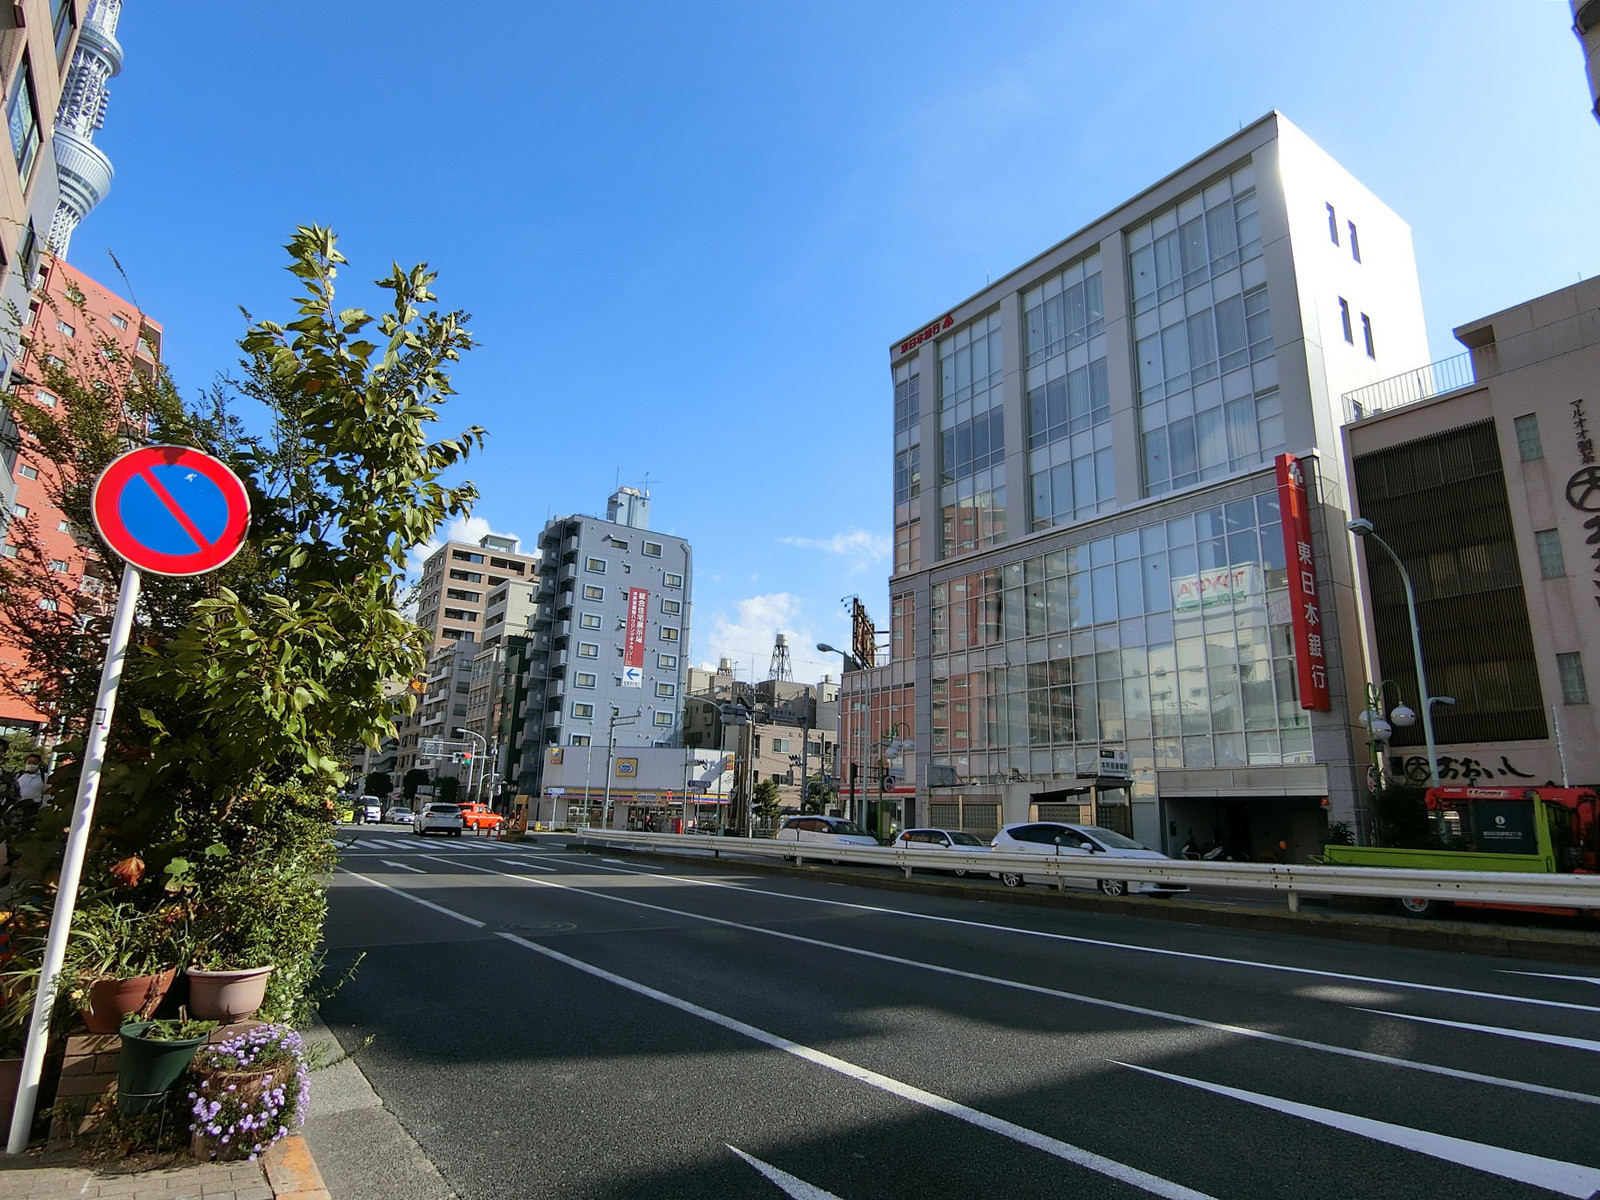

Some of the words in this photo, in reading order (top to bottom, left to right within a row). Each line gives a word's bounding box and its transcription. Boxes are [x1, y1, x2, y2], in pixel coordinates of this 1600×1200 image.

[901, 323, 940, 354] 東日本銀行
[1570, 398, 1595, 464] マルオオ製茶
[1297, 540, 1326, 690] 東日本銀行
[1437, 756, 1535, 779] おおいし
